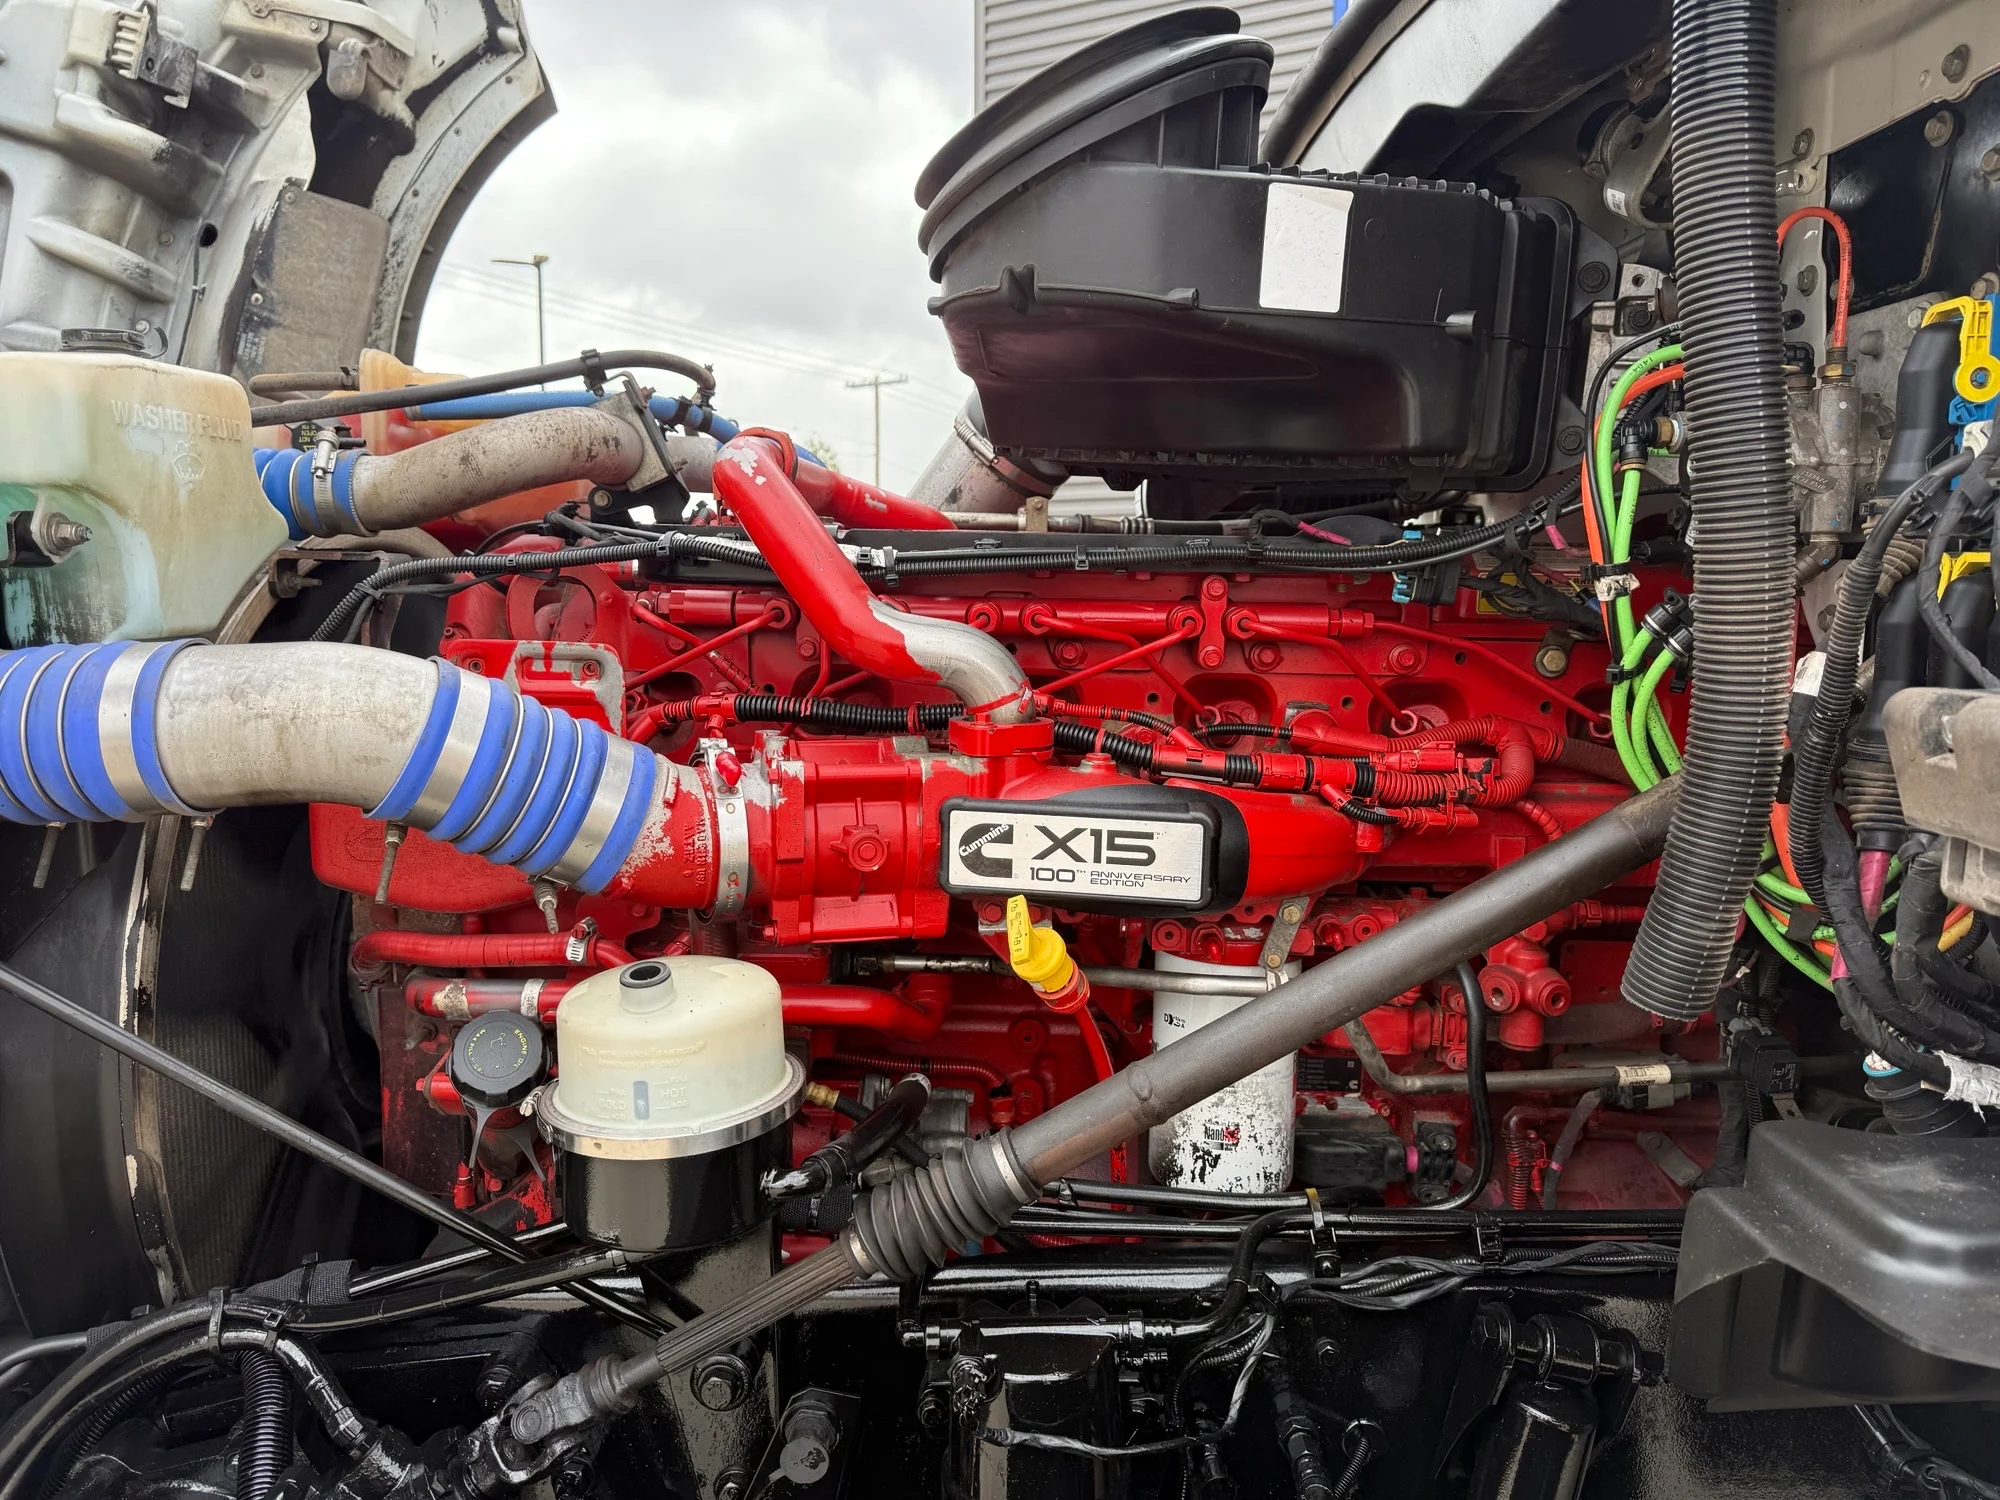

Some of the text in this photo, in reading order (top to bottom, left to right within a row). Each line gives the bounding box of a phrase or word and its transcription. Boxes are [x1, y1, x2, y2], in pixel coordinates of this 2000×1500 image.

[110, 399, 243, 442] WASHER FLUID
[959, 822, 1010, 857] Cummins
[1031, 824, 1157, 867] X15
[1090, 870, 1192, 884] ANNIVERSARY
[1090, 878, 1145, 888] EDITION
[472, 1028, 486, 1042] MAX
[513, 1028, 528, 1068] ENGINE OIL
[660, 1086, 687, 1099] HOT
[598, 1098, 627, 1110] COLD
